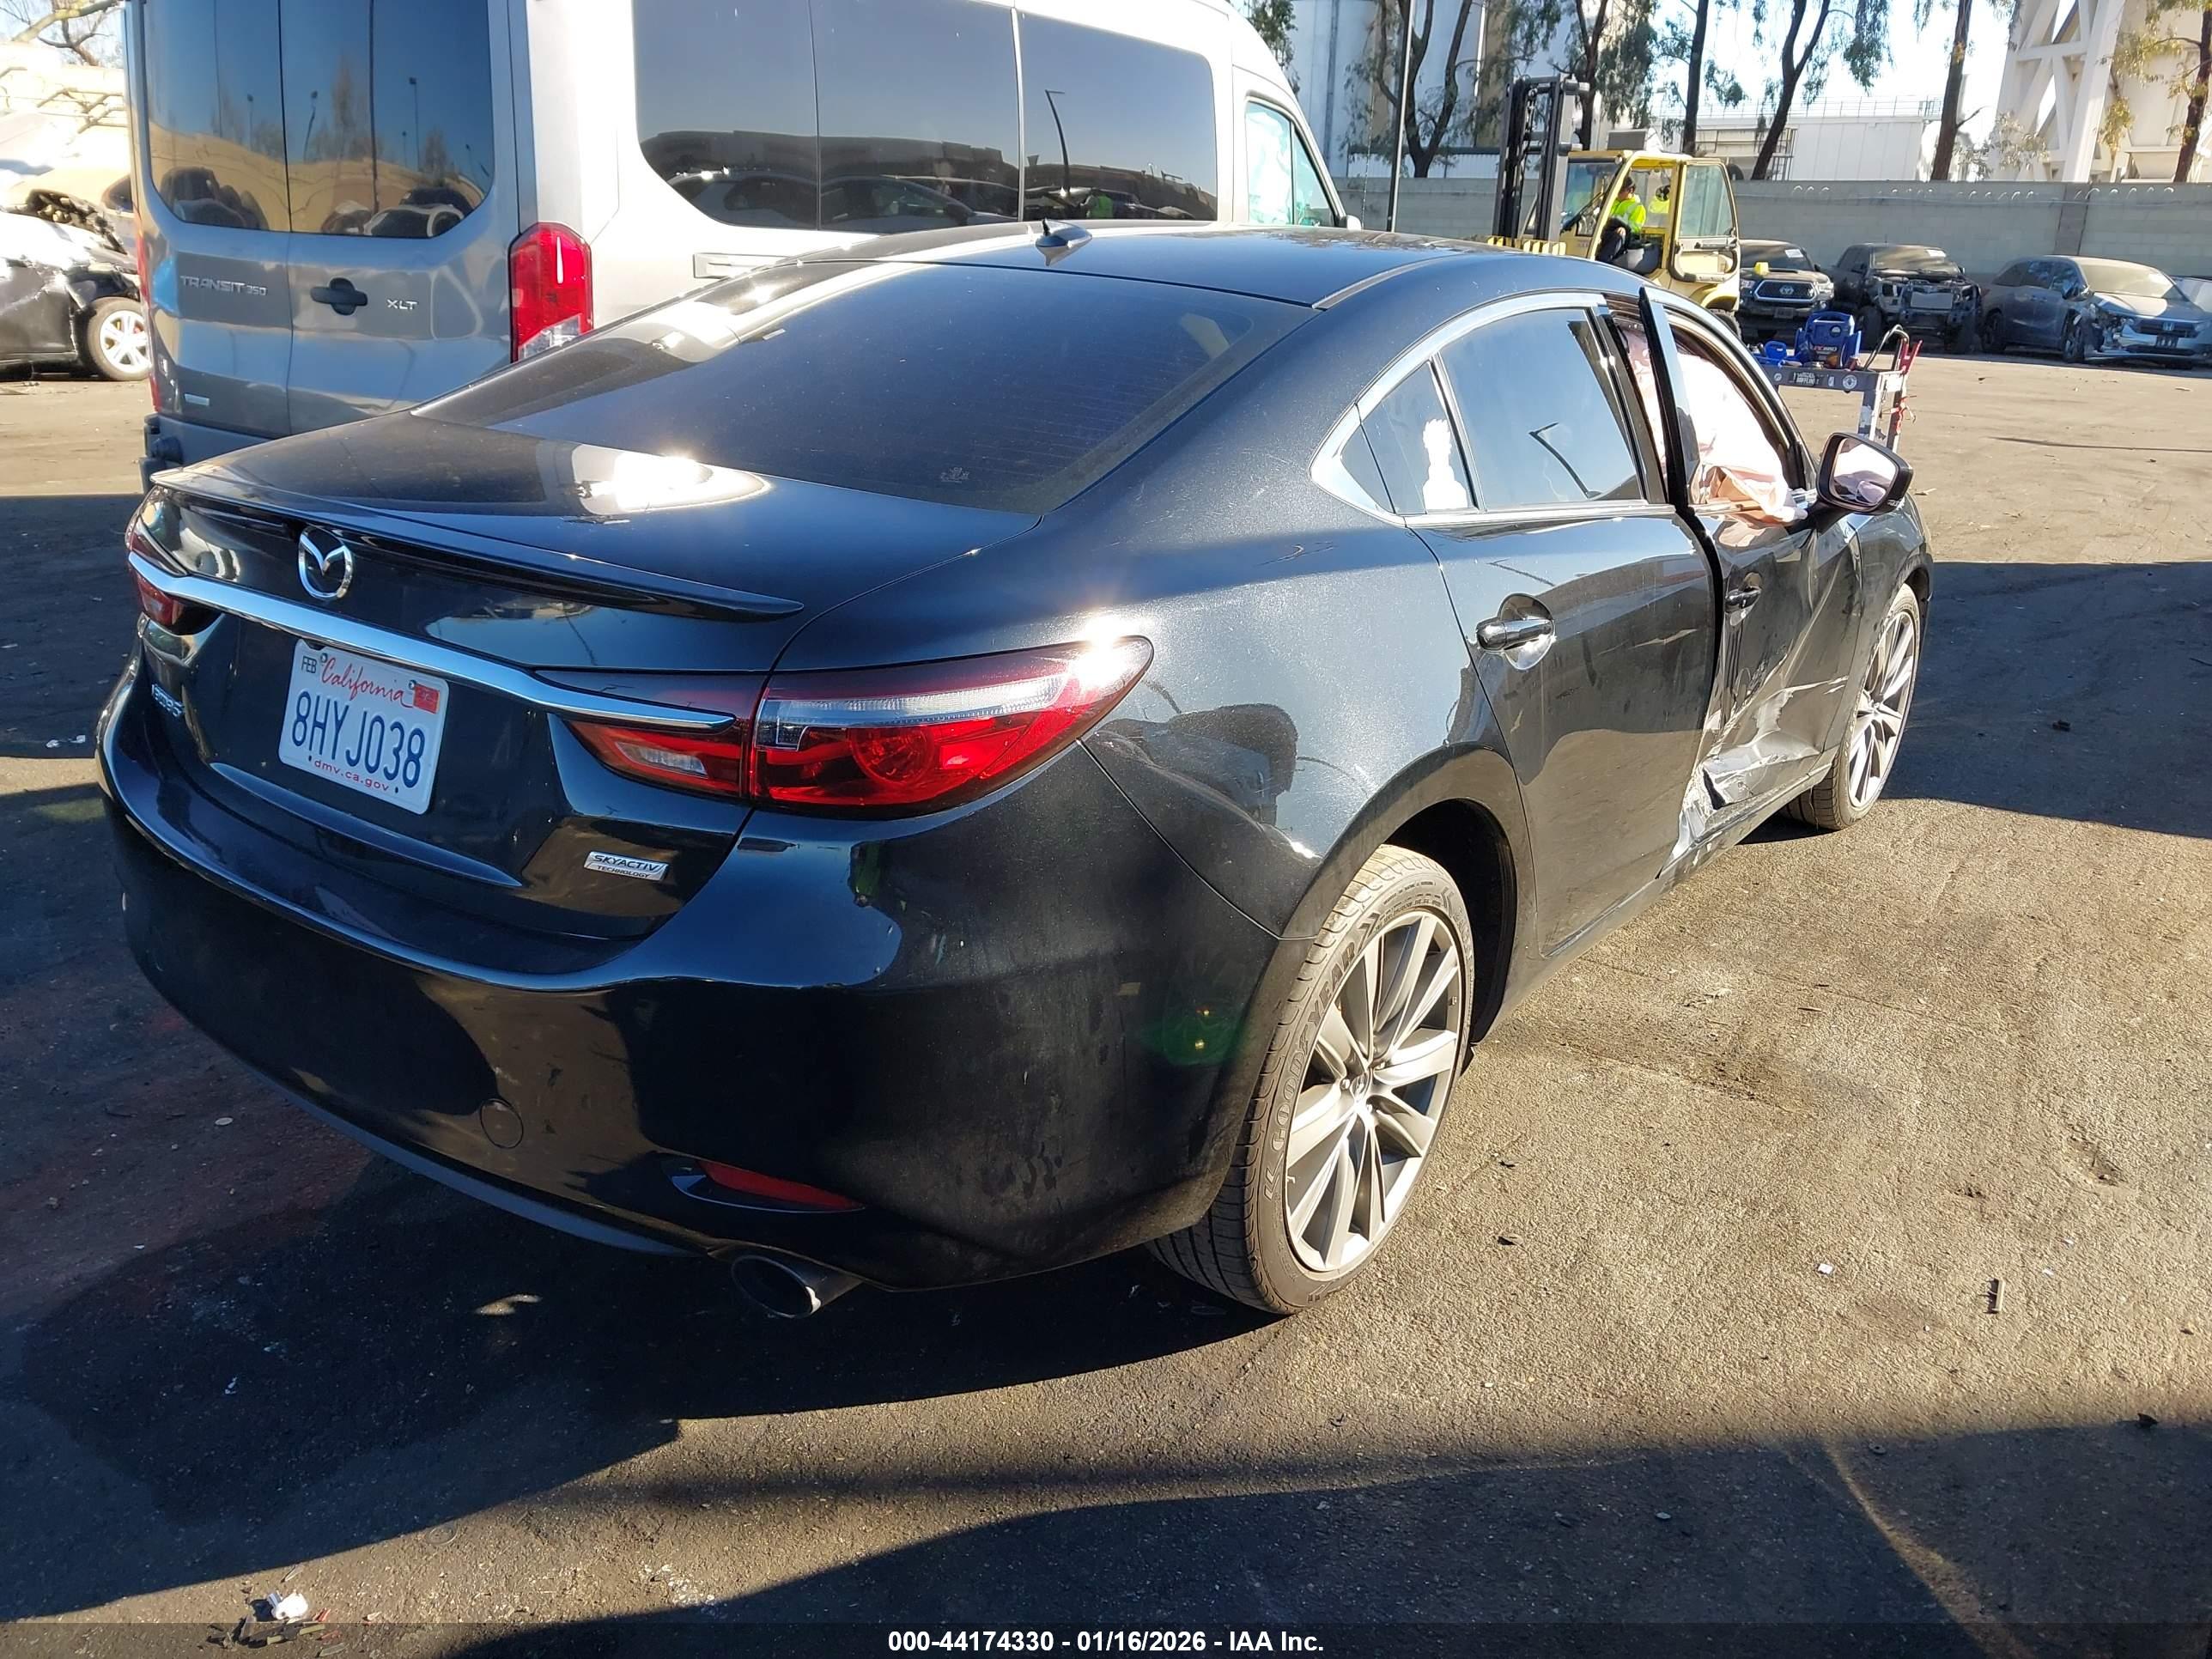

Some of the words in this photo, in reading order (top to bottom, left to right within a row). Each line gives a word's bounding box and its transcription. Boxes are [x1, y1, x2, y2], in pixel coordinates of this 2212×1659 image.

[179, 275, 246, 293] TRANSIT
[246, 285, 268, 296] 350
[386, 299, 418, 310] XLT
[301, 655, 318, 674] FEB
[321, 657, 413, 708] California
[291, 690, 426, 789] 8HYJ038
[314, 760, 389, 791] dmv.ca.gov
[593, 854, 660, 872] SKYACTIV
[598, 865, 653, 878] TECHNOLOGY
[1271, 941, 1355, 1152] GOODYEAR
